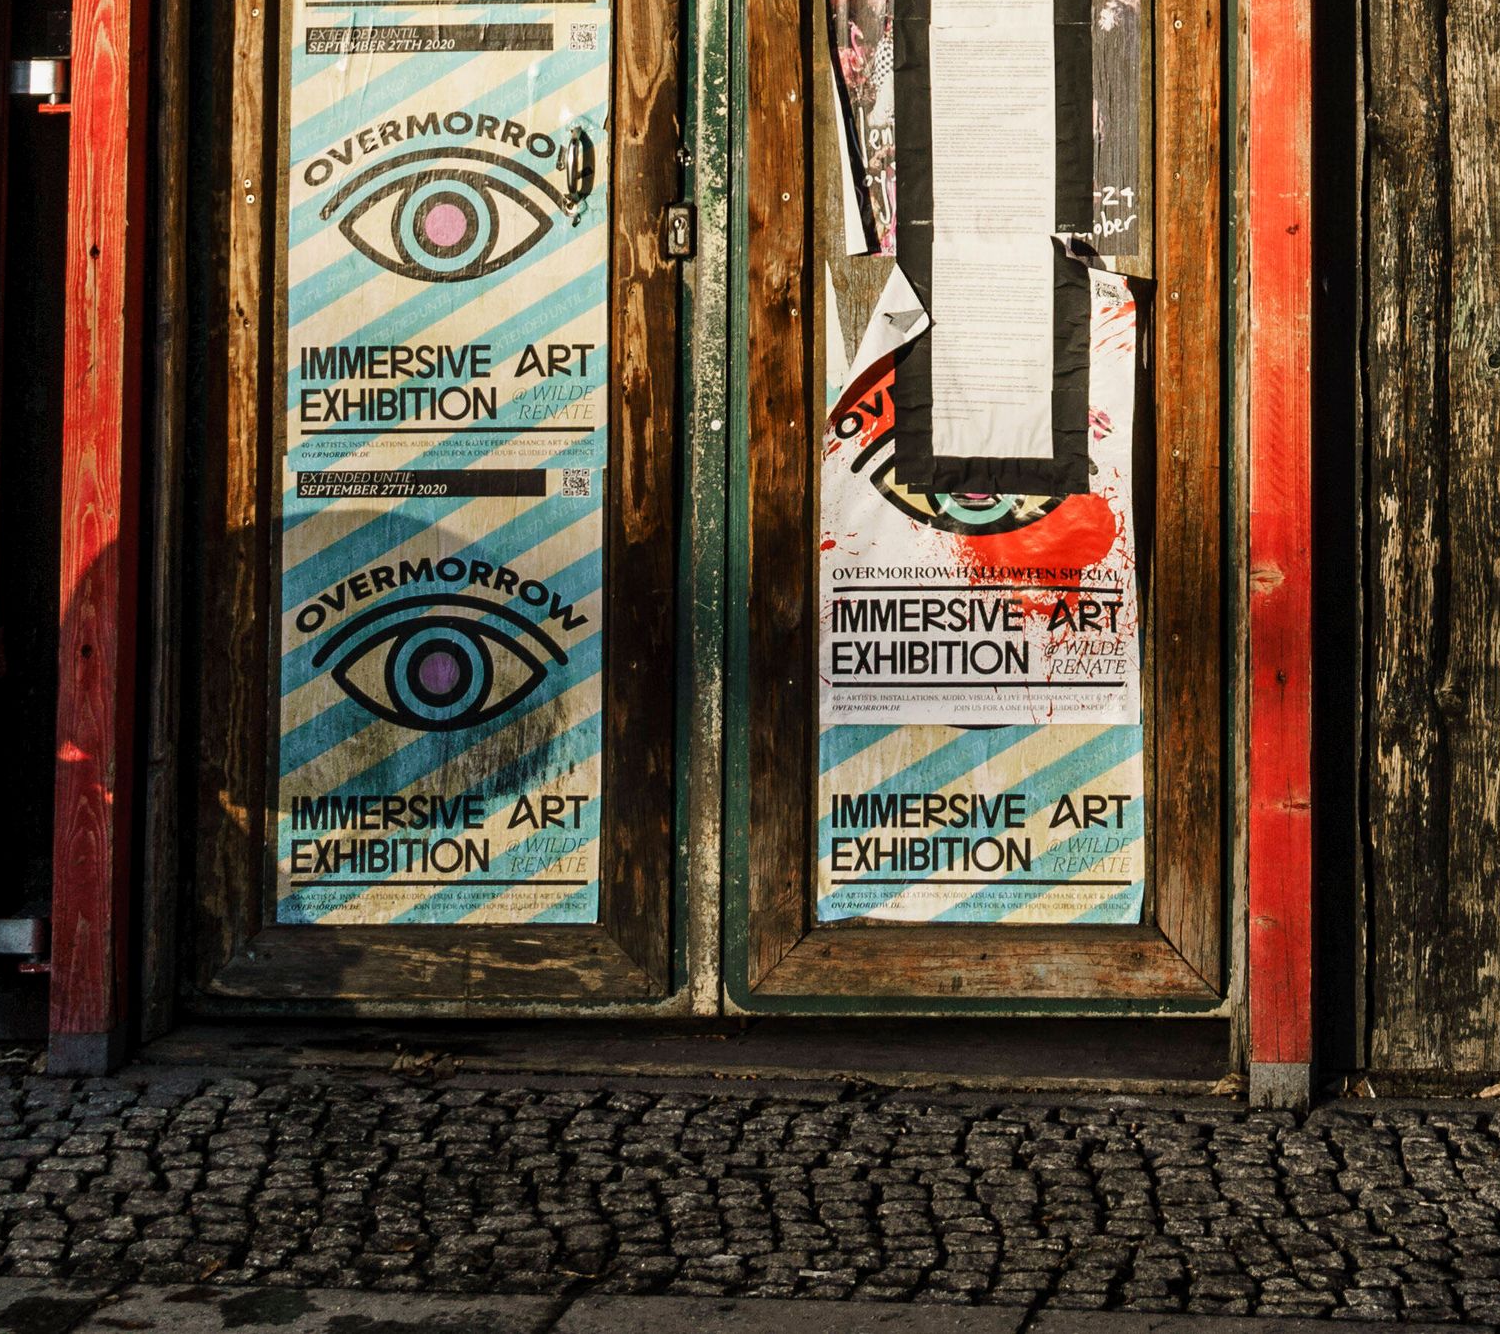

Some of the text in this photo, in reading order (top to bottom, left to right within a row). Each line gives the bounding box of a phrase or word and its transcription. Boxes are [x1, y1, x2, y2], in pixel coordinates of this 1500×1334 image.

[308, 28, 420, 41] EXTENDED UNTIL
[308, 38, 456, 53] SEPTEMBER 27TH 2020
[301, 344, 594, 380] IMMERSIVE ART
[531, 384, 595, 402] WILDE
[300, 386, 498, 422] EXHIBITION
[518, 404, 594, 420] RENATE
[300, 472, 373, 484] EXTENDED
[300, 484, 448, 496] SEPTEMBER 27TH 2020
[832, 566, 1122, 583] OVERMORROW HALLOWEEN SPECIAL
[295, 558, 589, 633] OVERMORROW
[832, 598, 1124, 634] IMMERSIVE ART
[1062, 640, 1128, 657] WILDE
[832, 640, 1029, 675] EXHIBITION
[1051, 658, 1128, 675] RENATE
[292, 794, 589, 830] IMMERSIVE ART
[832, 794, 1132, 829] IMMERSIVE ART
[525, 838, 590, 854] WILDE
[831, 836, 1031, 872] EXHIBITION
[1067, 837, 1132, 854] WILDE
[291, 838, 490, 874] EXHIBITION
[510, 856, 589, 873] RENATE
[1053, 856, 1132, 874] RENATE
